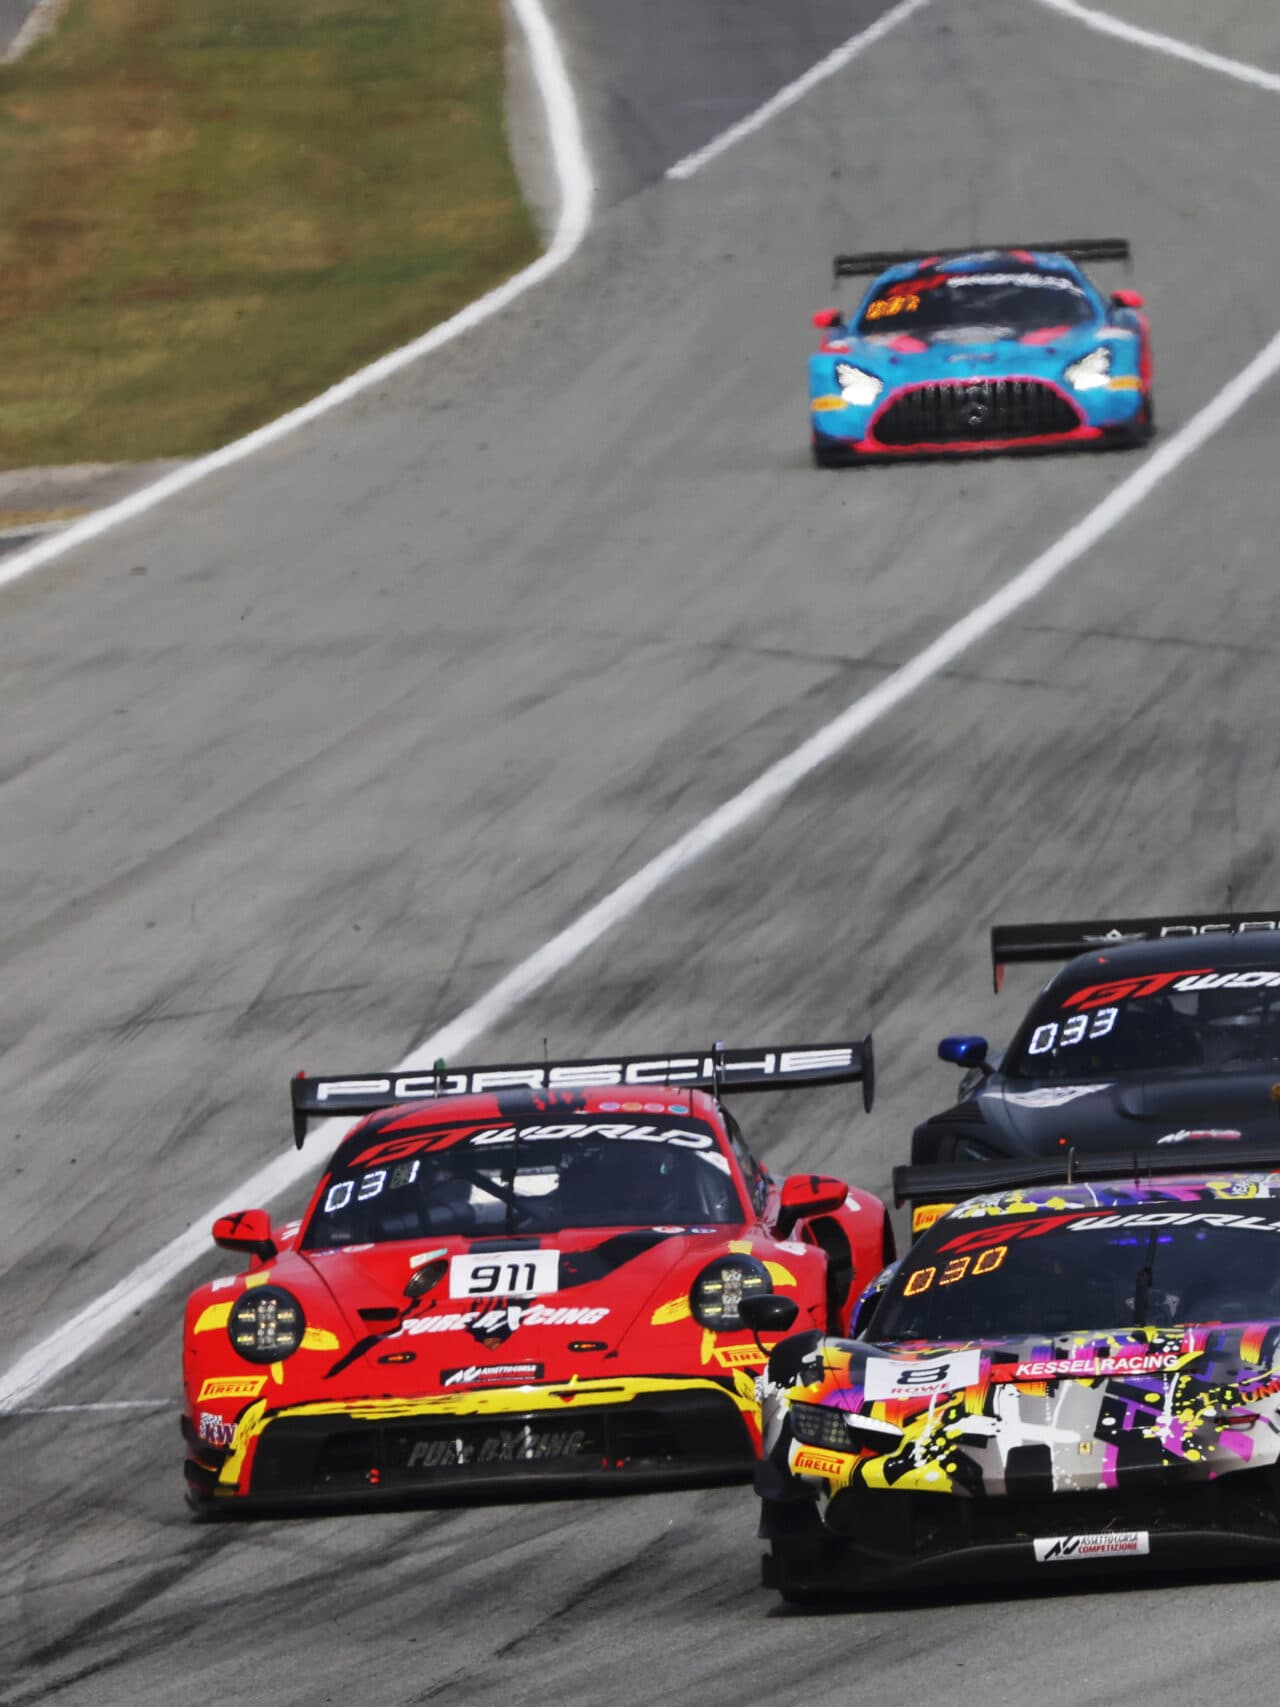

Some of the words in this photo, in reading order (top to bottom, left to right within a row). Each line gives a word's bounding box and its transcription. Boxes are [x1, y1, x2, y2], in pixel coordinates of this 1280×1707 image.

[1062, 968, 1214, 1011] GT
[1028, 1007, 1118, 1055] 033
[316, 1048, 853, 1101] PORSCHE
[347, 1121, 516, 1169] GT
[470, 1124, 713, 1149] WORLD
[325, 1160, 420, 1213] 031
[935, 1211, 1117, 1255] GT
[468, 1263, 537, 1294] 911
[903, 1245, 1009, 1297] 030
[896, 1363, 951, 1385] 8
[1016, 1359, 1094, 1377] KESSEL
[1100, 1354, 1179, 1371] RACING
[204, 1380, 259, 1396] PIRELLI
[891, 1383, 950, 1394] ROWE
[795, 1451, 845, 1475] PIRELLI
[1078, 1541, 1137, 1554] COMPETIZIONE
